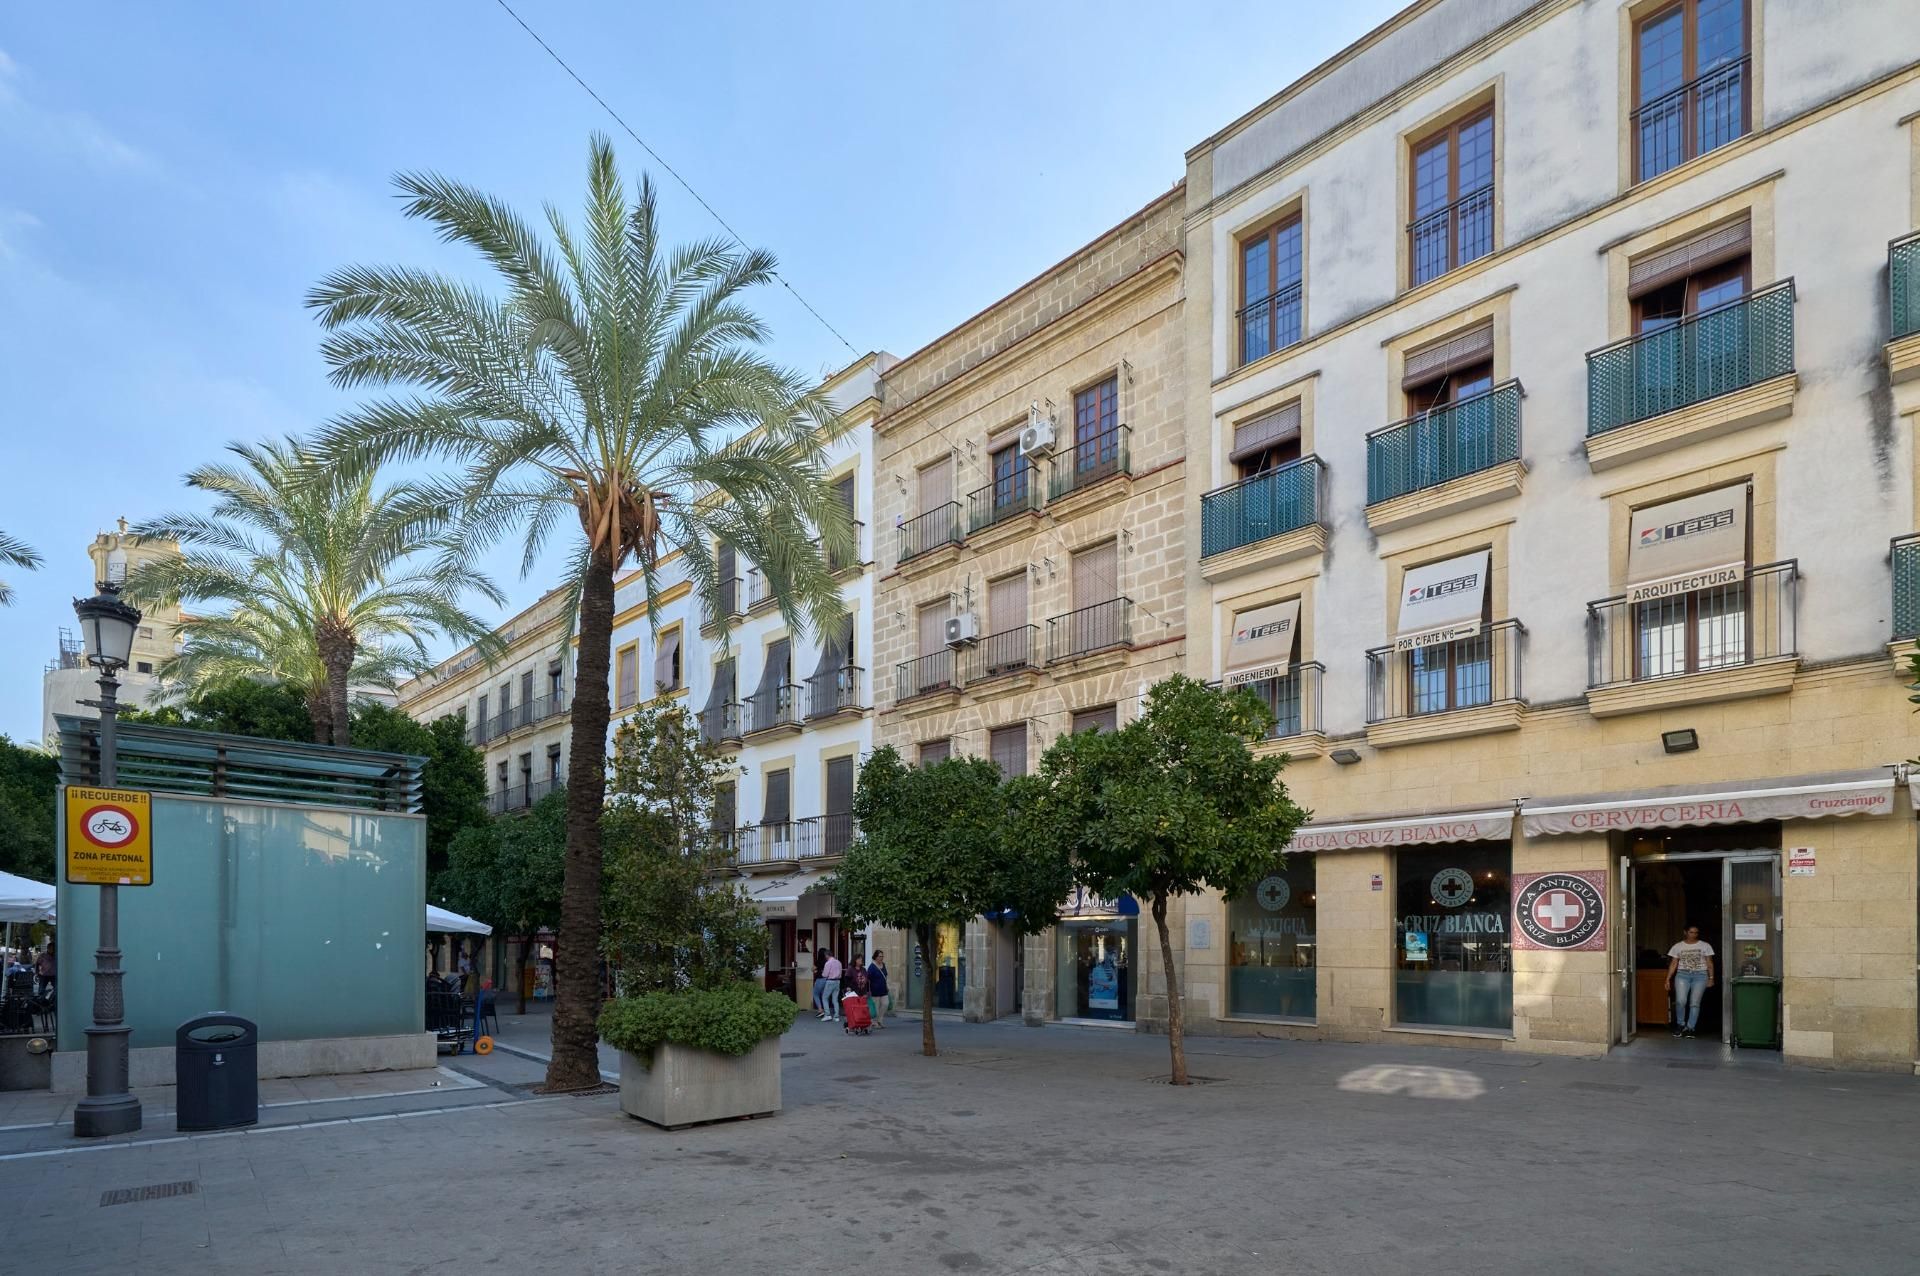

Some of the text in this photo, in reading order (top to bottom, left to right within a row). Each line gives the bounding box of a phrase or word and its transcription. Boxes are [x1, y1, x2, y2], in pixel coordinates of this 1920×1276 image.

[1633, 570, 1737, 601] ARQUITECTURA
[1398, 639, 1413, 650] POR
[1230, 667, 1279, 684] INGENIERIA
[1809, 796, 1885, 808] Cruzcampo
[1290, 823, 1479, 850] TIGUA CRUZ BLANCA
[73, 851, 144, 863] ZONA PEATONAL
[1521, 879, 1597, 909] LA ANTIGUA
[1404, 914, 1504, 933] CRUZ BLANCA
[1523, 918, 1596, 944] CRUZ BLANCA
